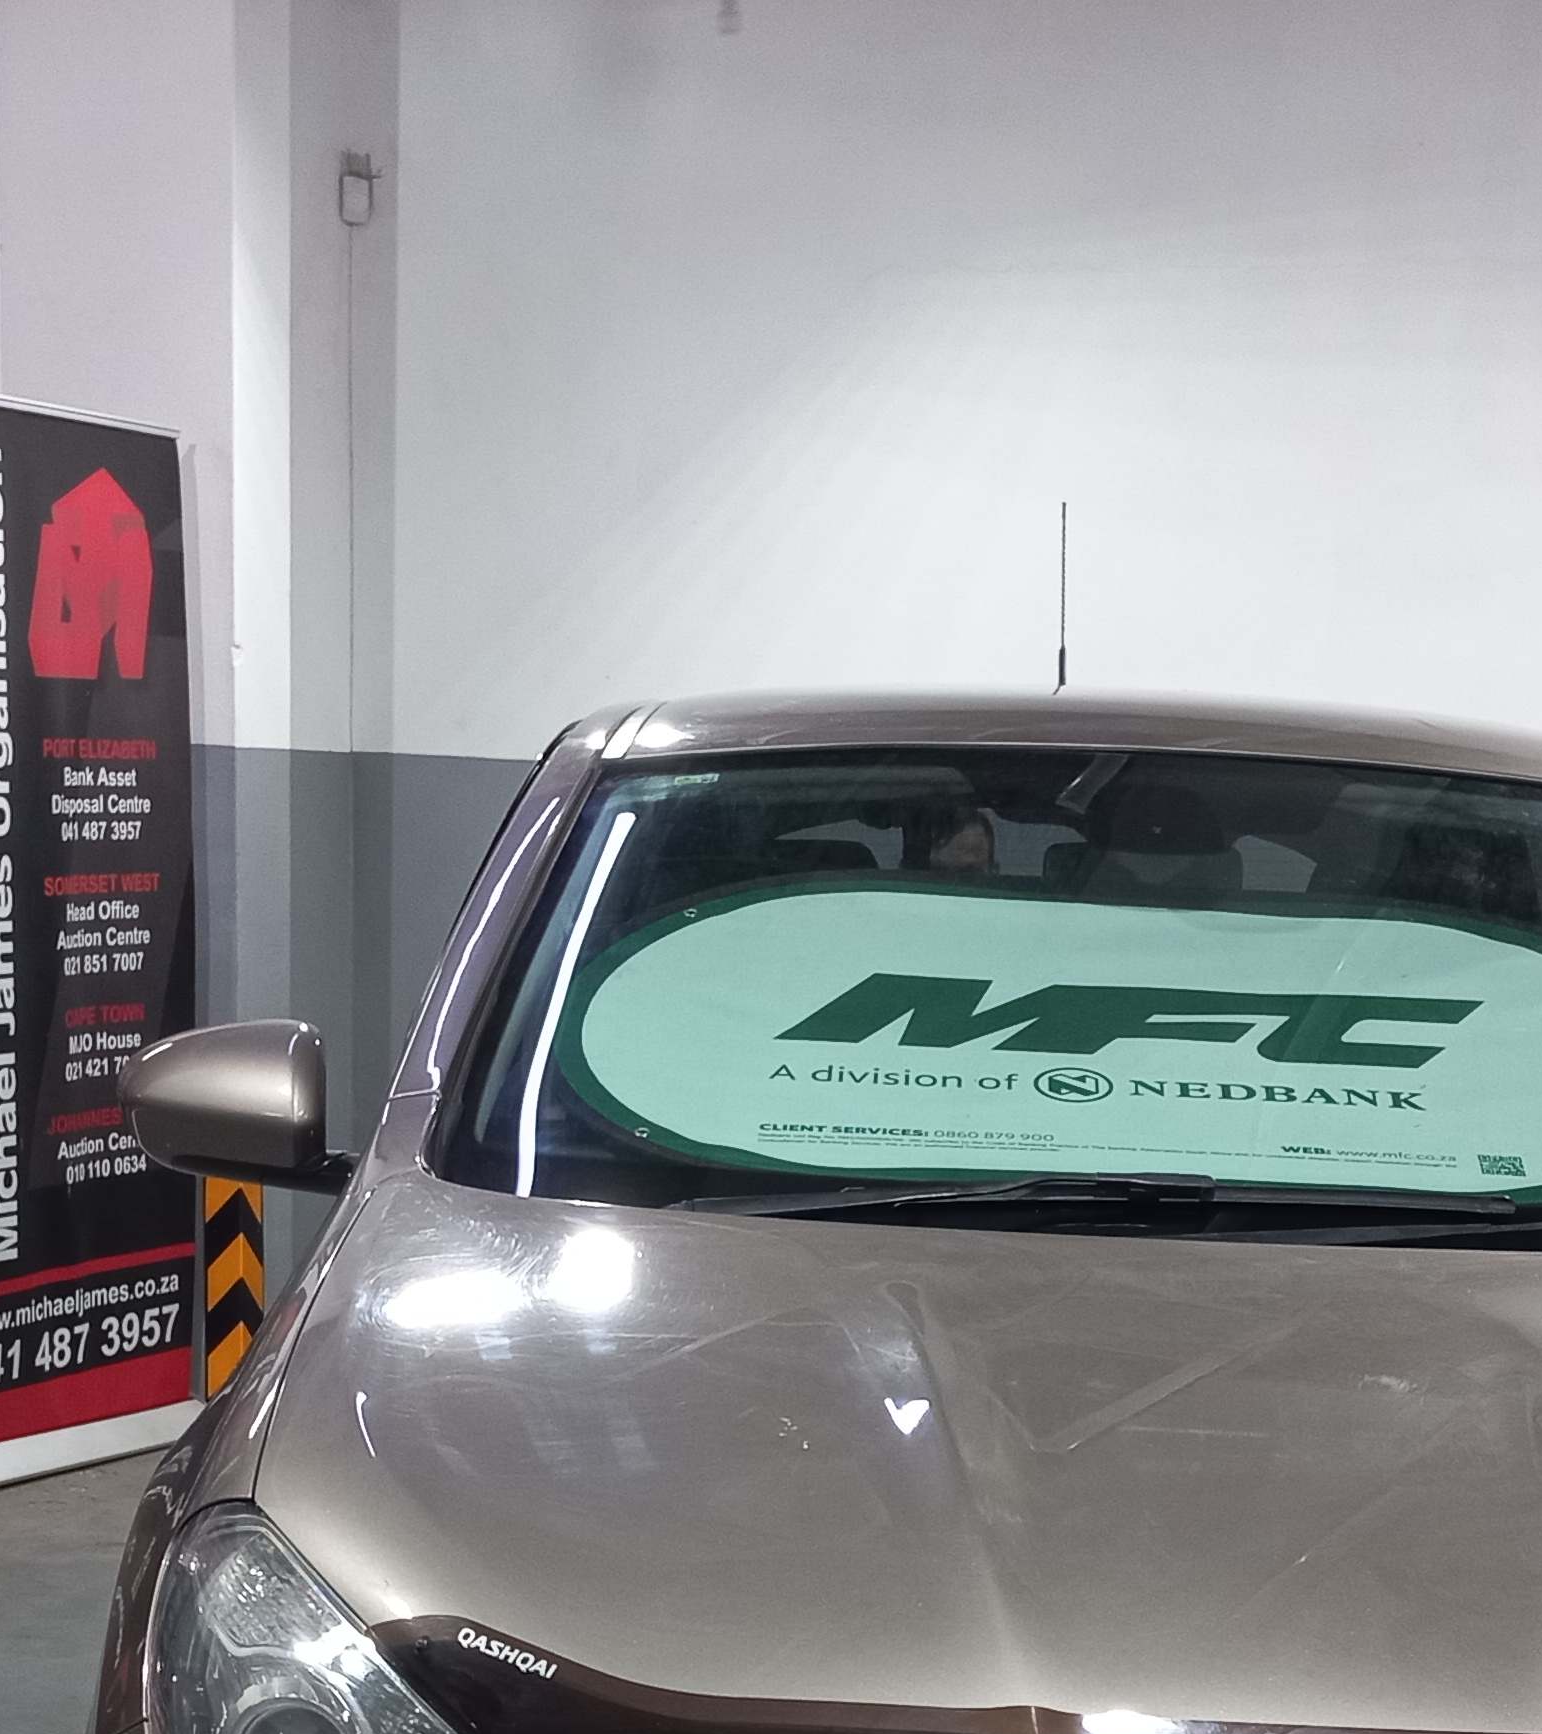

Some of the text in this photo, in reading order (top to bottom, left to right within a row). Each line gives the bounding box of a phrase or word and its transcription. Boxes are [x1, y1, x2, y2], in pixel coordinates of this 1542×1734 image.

[64, 766, 137, 787] Bank Asset
[52, 794, 151, 818] Disposal Centre
[67, 900, 139, 922] Head Office
[57, 927, 150, 950] Auction Centre
[773, 973, 1484, 1069] MFC
[769, 1064, 1426, 1111] A division of NEDBANK
[759, 1123, 827, 1132] CLIENT
[832, 1126, 929, 1136] SERVICES:
[1281, 1146, 1331, 1155] WEB:
[35, 1322, 89, 1372] 487
[101, 1303, 179, 1356] 3957
[457, 1627, 557, 1678] QASHQAI
